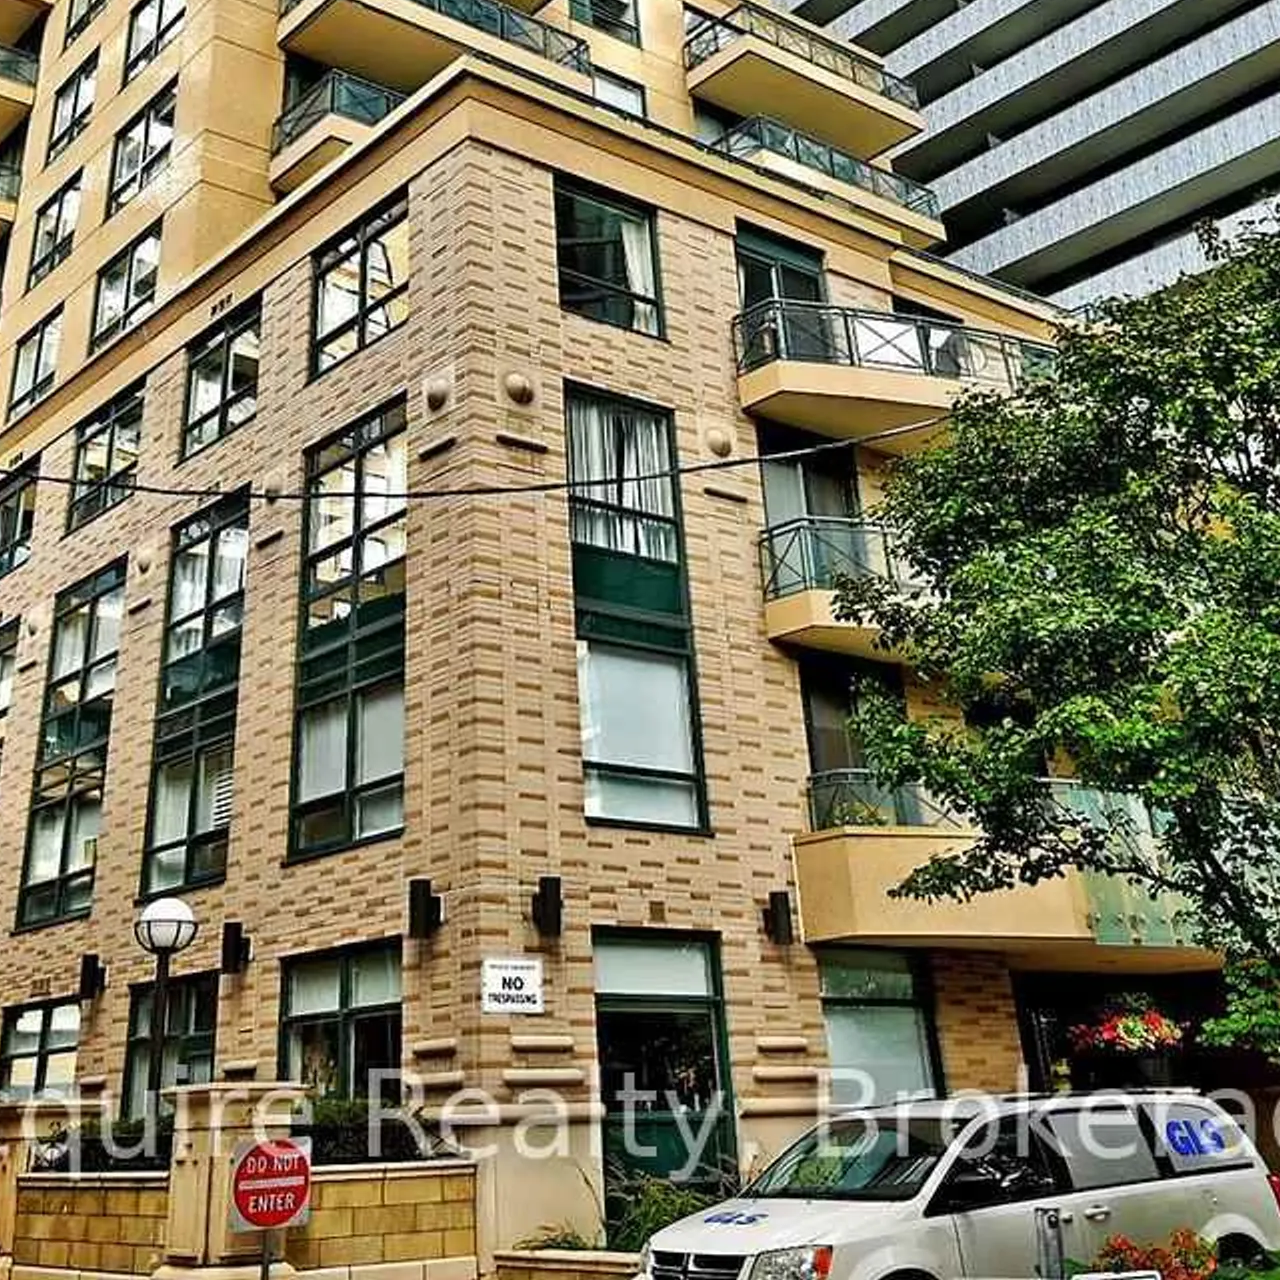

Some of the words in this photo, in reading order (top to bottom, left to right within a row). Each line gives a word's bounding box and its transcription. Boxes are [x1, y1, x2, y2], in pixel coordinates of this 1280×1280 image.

[502, 976, 524, 990] NO
[246, 1156, 267, 1173] DO
[273, 1153, 299, 1171] NOT
[248, 1192, 294, 1214] ENTER
